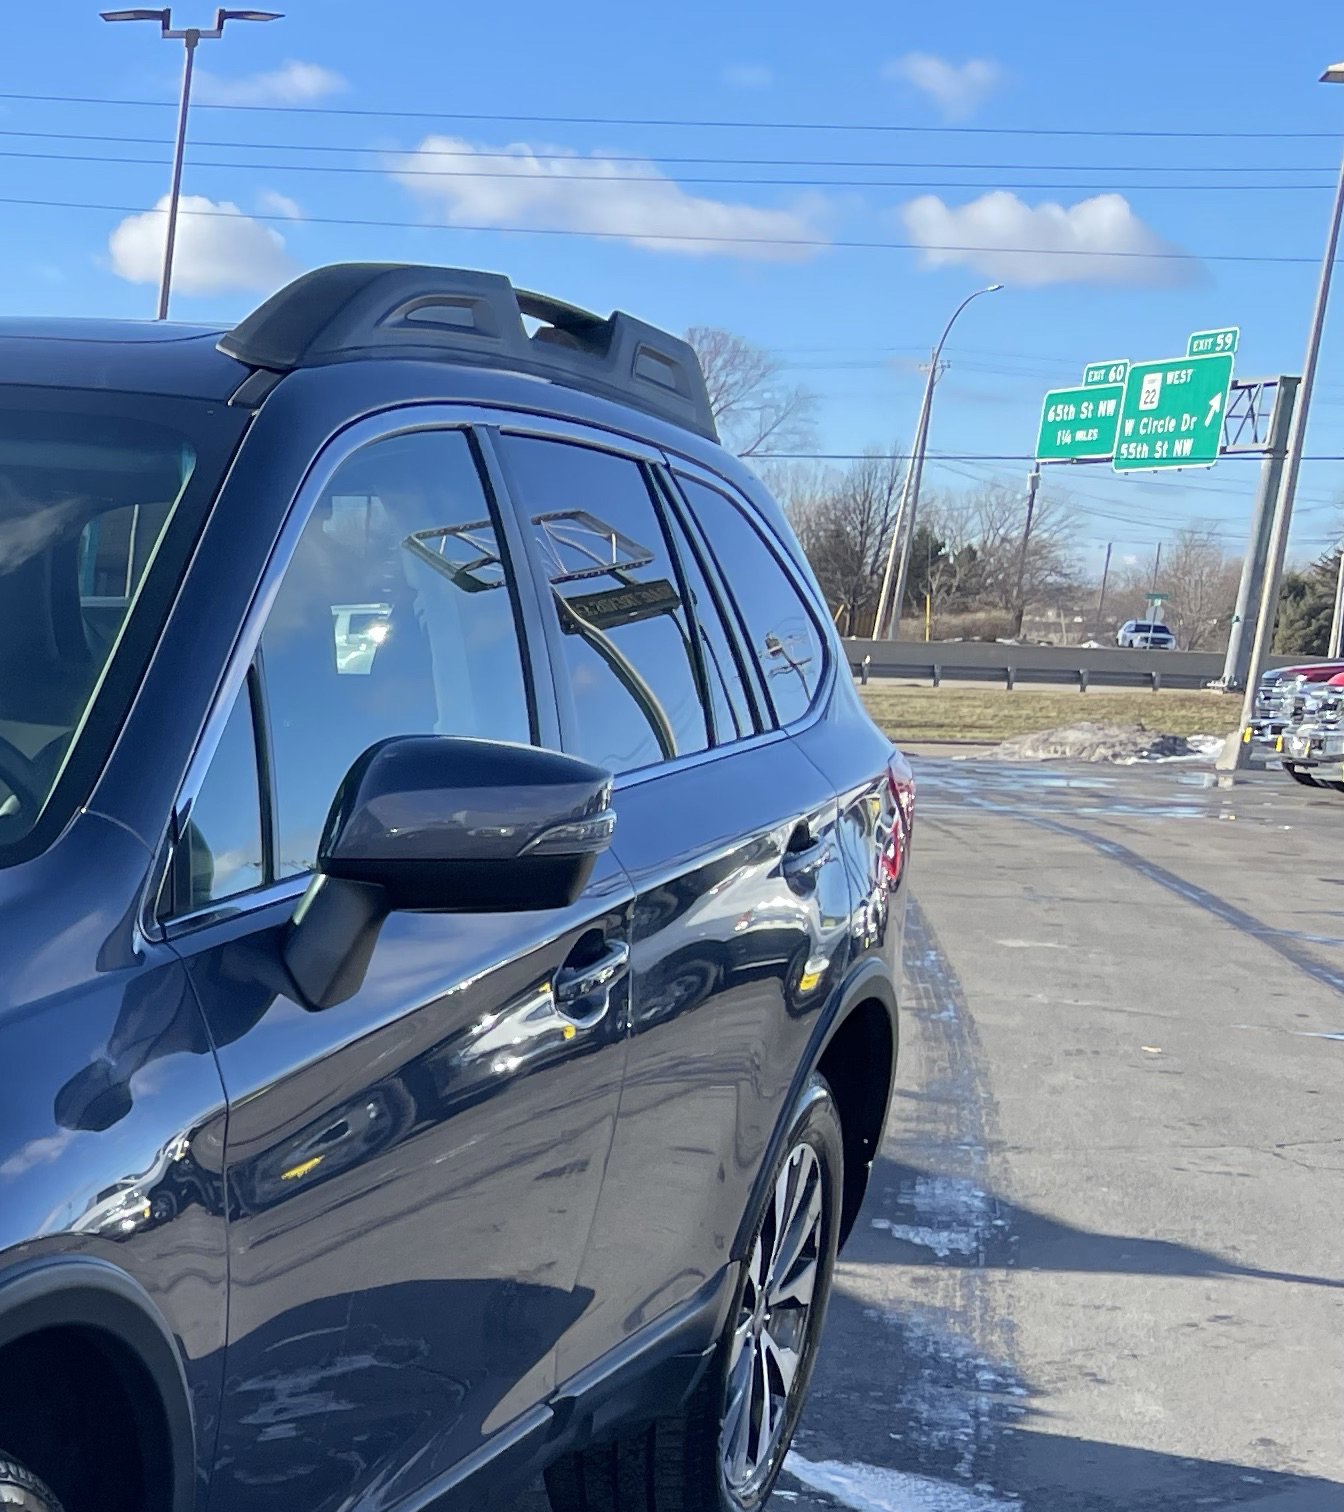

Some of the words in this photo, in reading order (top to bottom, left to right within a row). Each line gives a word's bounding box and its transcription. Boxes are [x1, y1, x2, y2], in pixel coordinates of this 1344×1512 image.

[1192, 339, 1213, 352] EXIT
[1215, 333, 1233, 351] 59
[1087, 369, 1105, 382] EXIT
[1108, 365, 1124, 382] 60
[1166, 368, 1194, 384] WEST
[1143, 389, 1157, 405] 22
[1047, 403, 1075, 422] 65th
[1080, 401, 1094, 419] St
[1098, 399, 1117, 417] NW
[1124, 419, 1135, 436] W
[1139, 416, 1176, 435] Circle
[1181, 413, 1198, 431] Dr
[1075, 429, 1099, 441] MILES
[1120, 443, 1149, 459] 55th
[1155, 440, 1168, 458] St
[1173, 438, 1194, 457] NW
